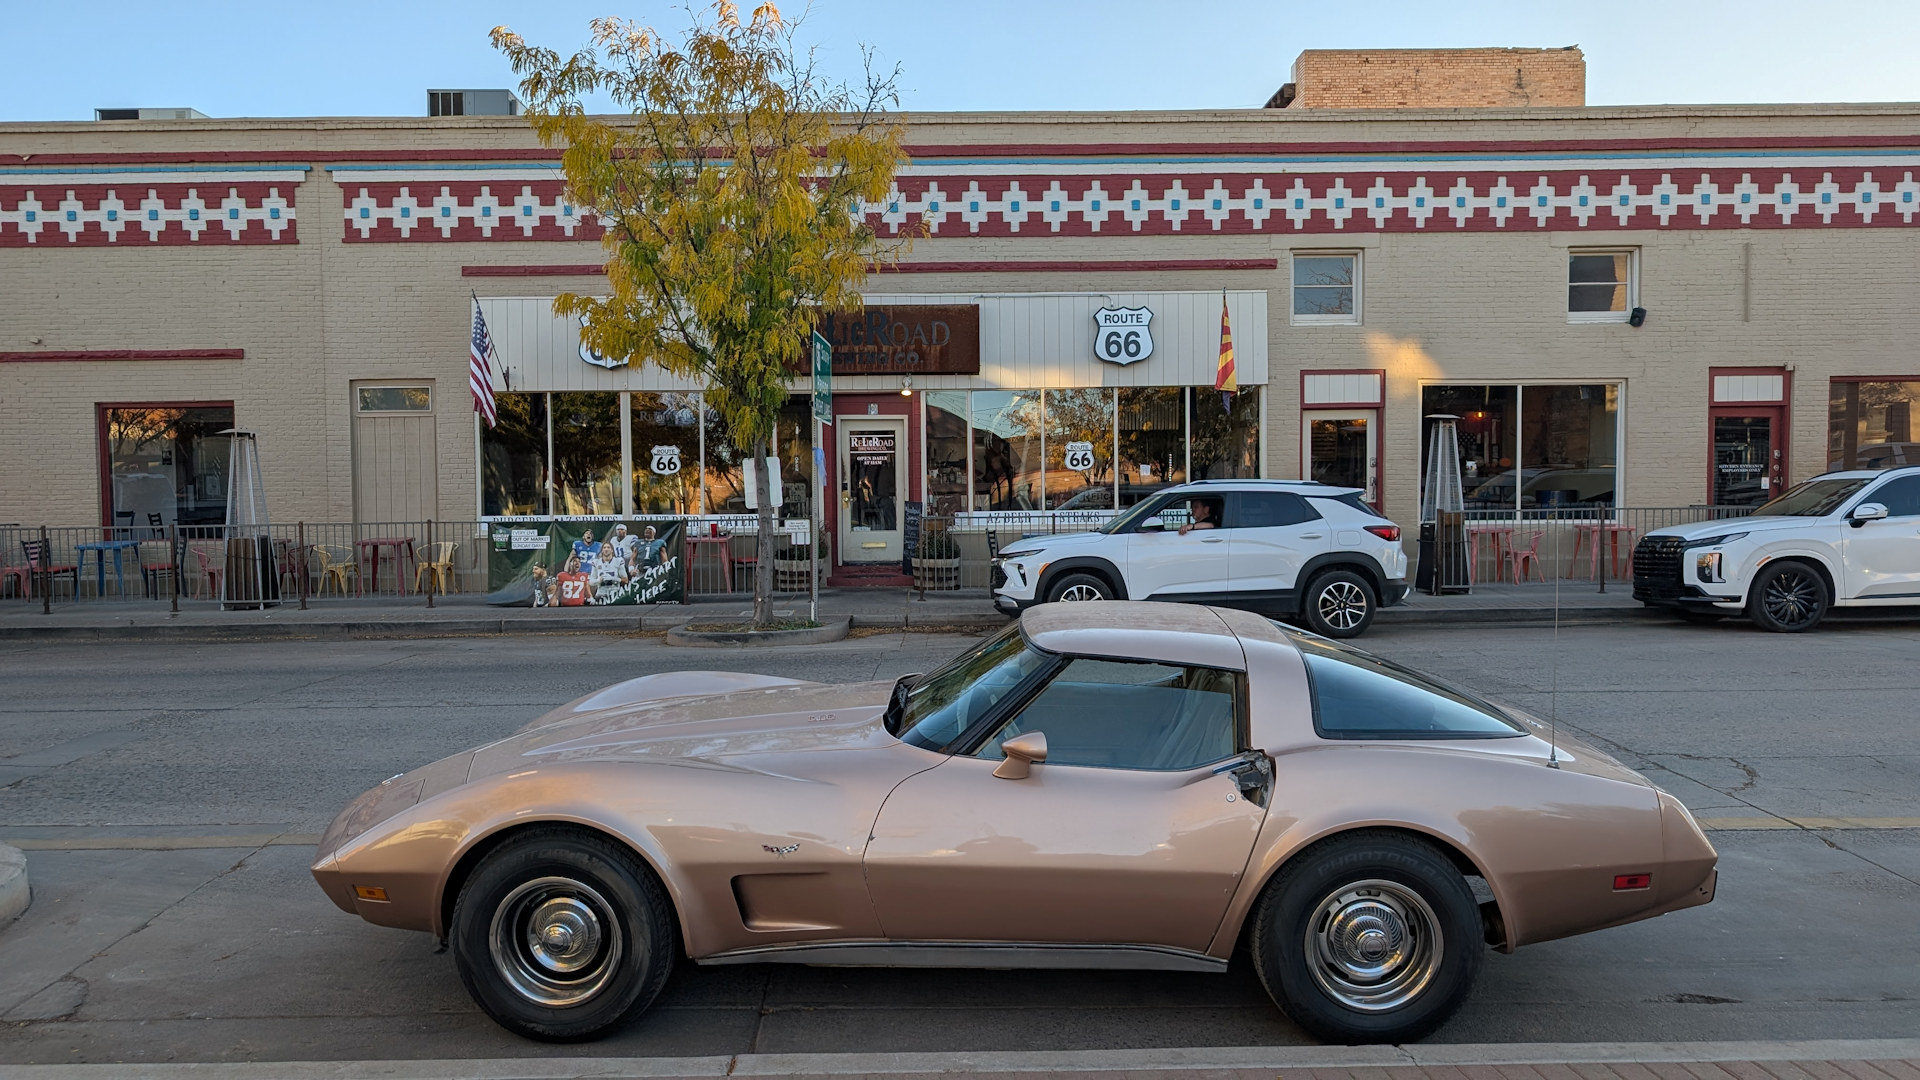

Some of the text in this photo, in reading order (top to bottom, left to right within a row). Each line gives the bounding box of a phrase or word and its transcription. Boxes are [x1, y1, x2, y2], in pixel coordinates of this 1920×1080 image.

[1104, 313, 1143, 324] ROUTE
[809, 310, 950, 348] LICROAD
[1104, 330, 1141, 358] 66
[894, 351, 924, 366] CO.
[656, 456, 677, 471] 66
[1069, 452, 1091, 467] 66
[987, 512, 1001, 524] AZ
[1059, 511, 1100, 523] STEAKS
[644, 546, 651, 559] 1
[643, 556, 678, 585] START
[562, 581, 585, 599] 87
[633, 579, 667, 604] HERE
[1317, 850, 1419, 877] PHANTOM
